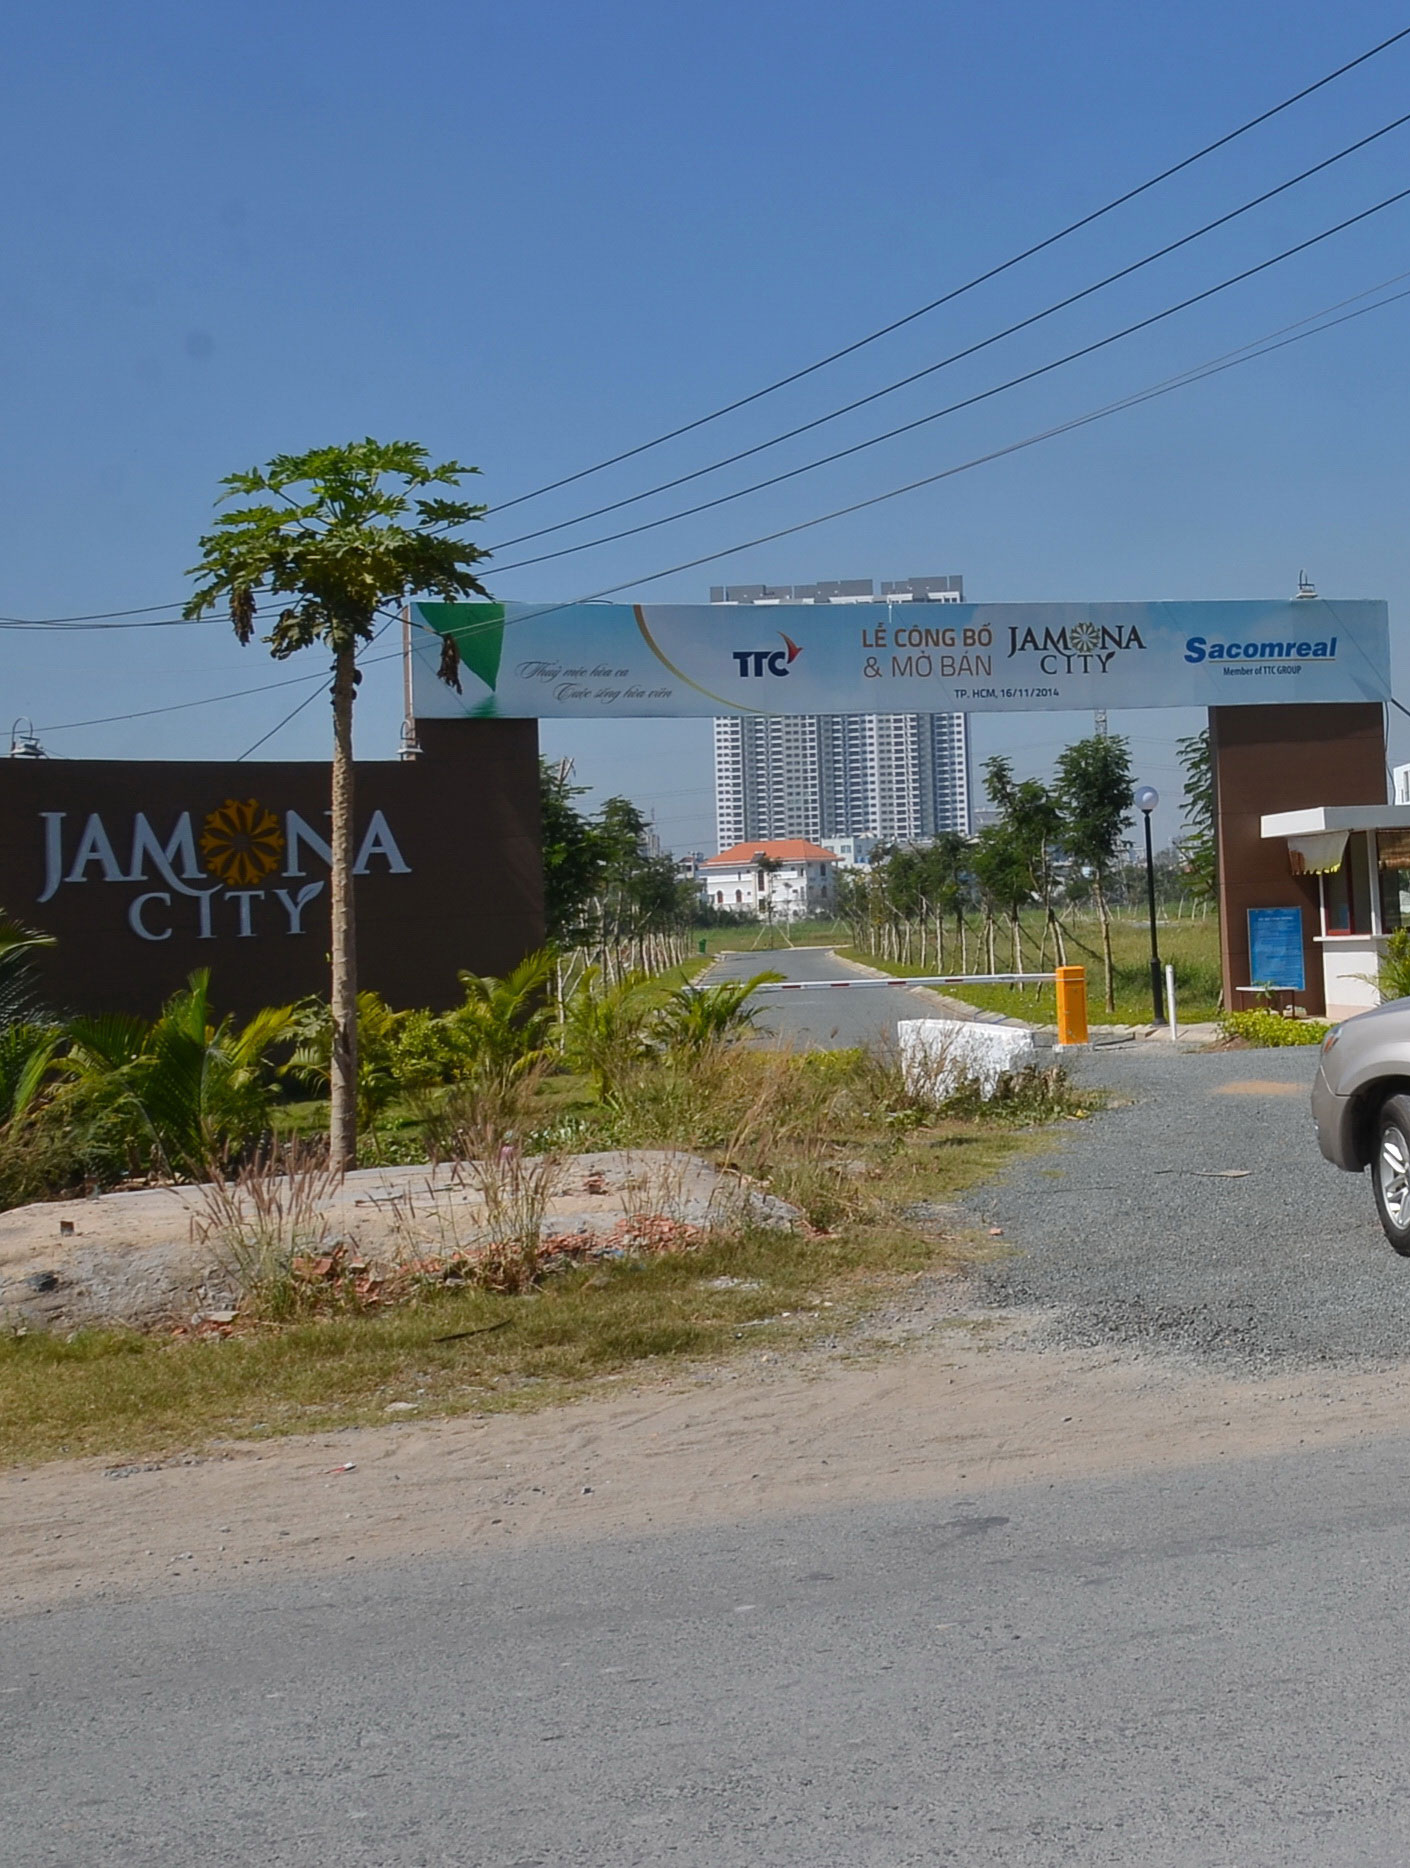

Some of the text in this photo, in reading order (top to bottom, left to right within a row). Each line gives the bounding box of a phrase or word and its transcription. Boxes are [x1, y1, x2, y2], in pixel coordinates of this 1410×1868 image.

[862, 622, 993, 648] LỄ CÔNG BỐ
[1007, 621, 1147, 659] JAMONA
[1040, 651, 1116, 675] CITY
[1184, 636, 1337, 664] Sacomreal
[732, 651, 790, 677] TTC
[863, 656, 883, 678] &
[941, 650, 992, 677] BÁN
[1223, 667, 1253, 676] Member
[1254, 666, 1263, 675] of
[1000, 687, 1060, 698] 16/11/2014
[128, 880, 325, 941] CITY
